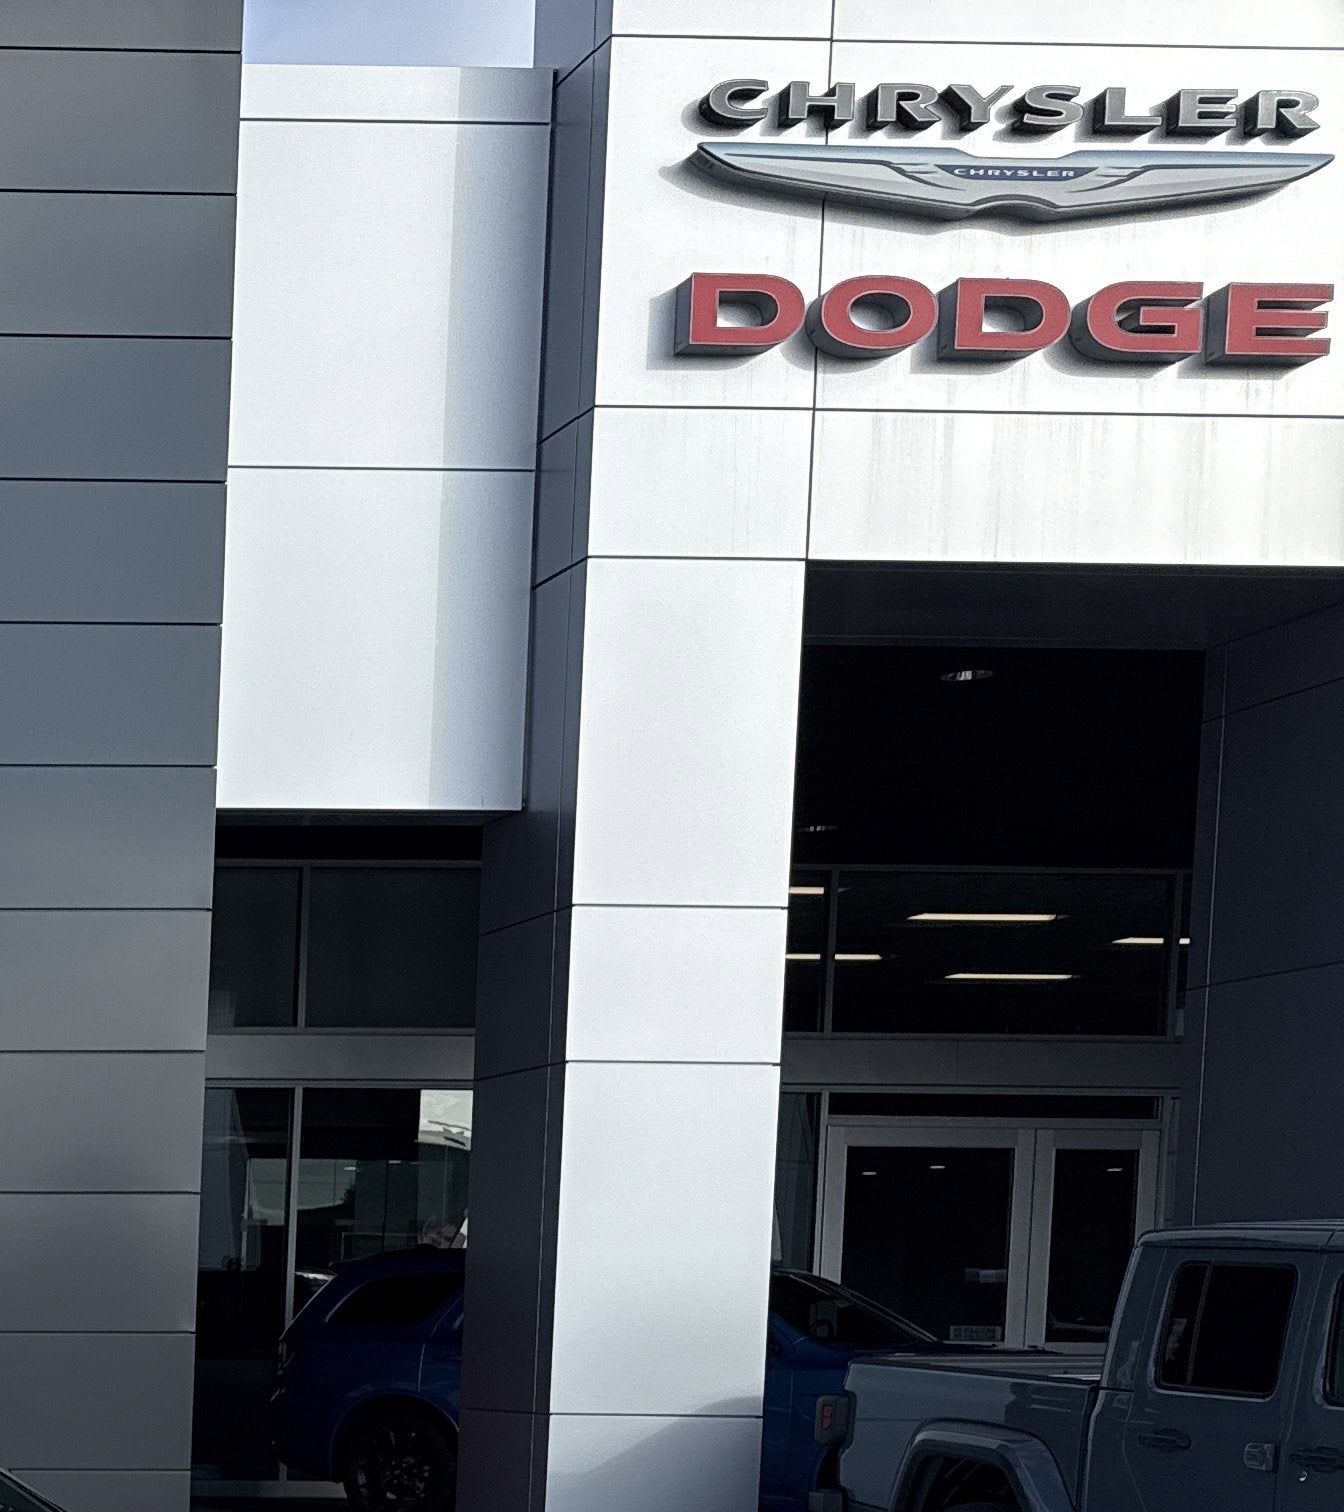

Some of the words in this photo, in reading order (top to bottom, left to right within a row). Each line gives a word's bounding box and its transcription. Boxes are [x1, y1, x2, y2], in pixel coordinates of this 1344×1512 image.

[702, 78, 1321, 131] CHRYSLER
[953, 168, 1076, 178] CHRYSLER
[678, 271, 1334, 358] DODGE
